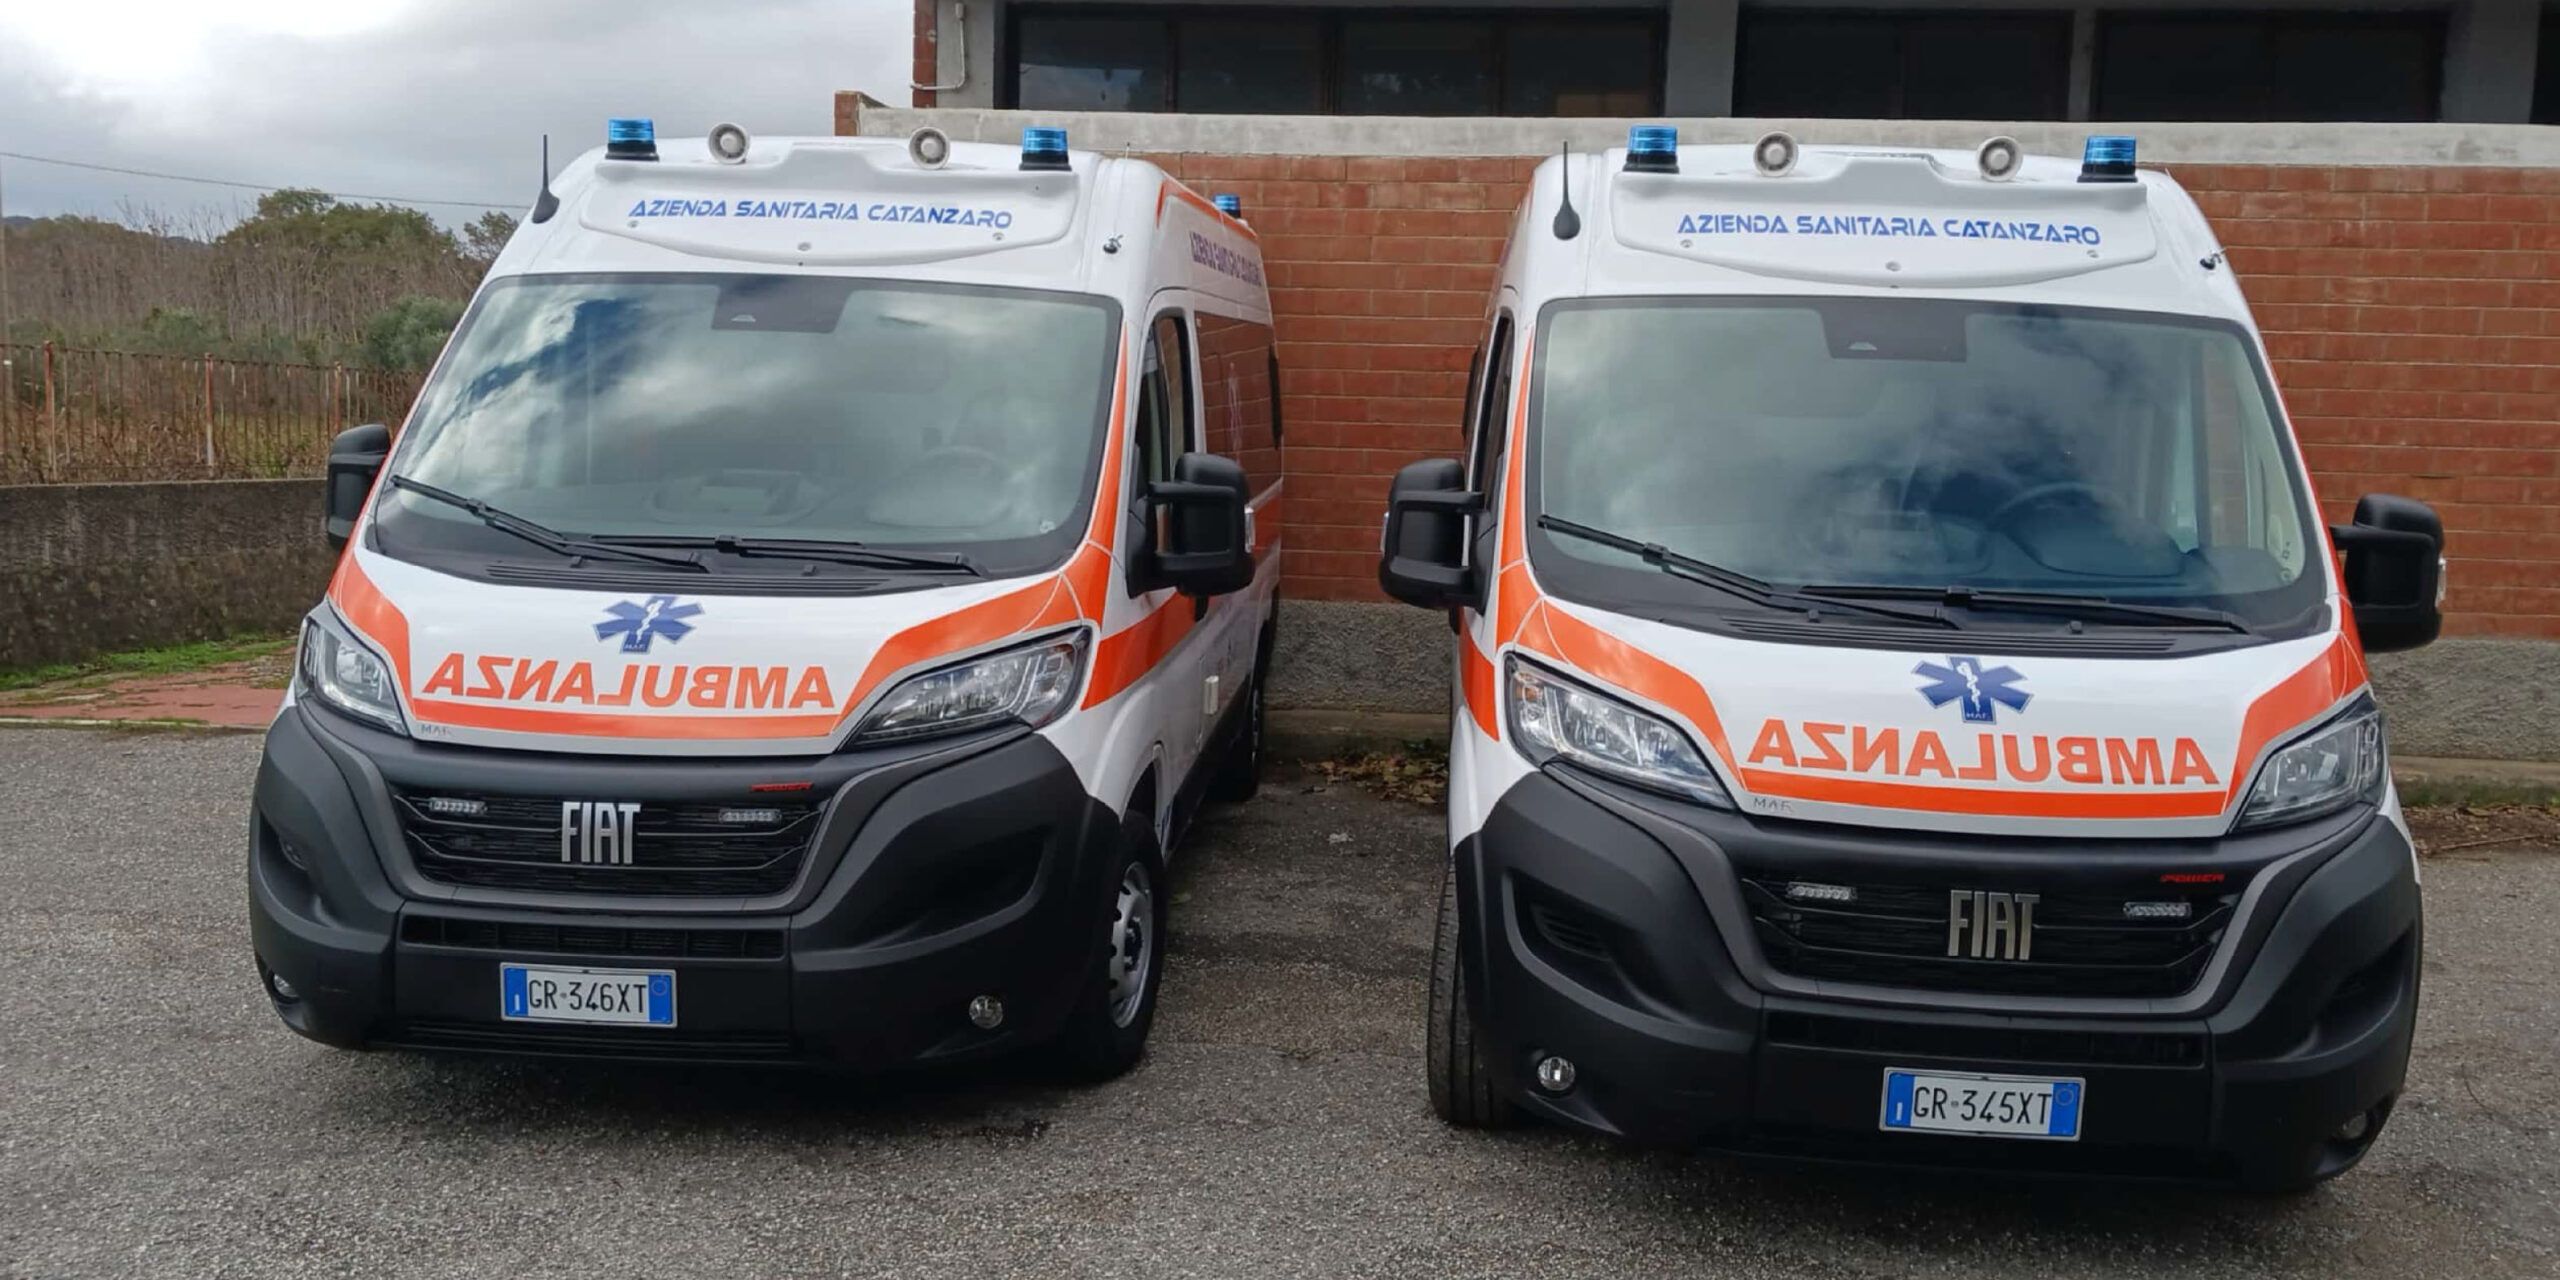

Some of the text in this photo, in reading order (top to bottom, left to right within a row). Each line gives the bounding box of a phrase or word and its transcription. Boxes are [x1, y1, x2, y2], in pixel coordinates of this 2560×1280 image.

[628, 199, 1013, 230] AZIENDA SANITARIA CATANZARO
[1677, 214, 2101, 246] AZIENDA SANITARIA CATANZARO
[561, 801, 641, 865] FIAT
[1948, 889, 2041, 961] FIAT
